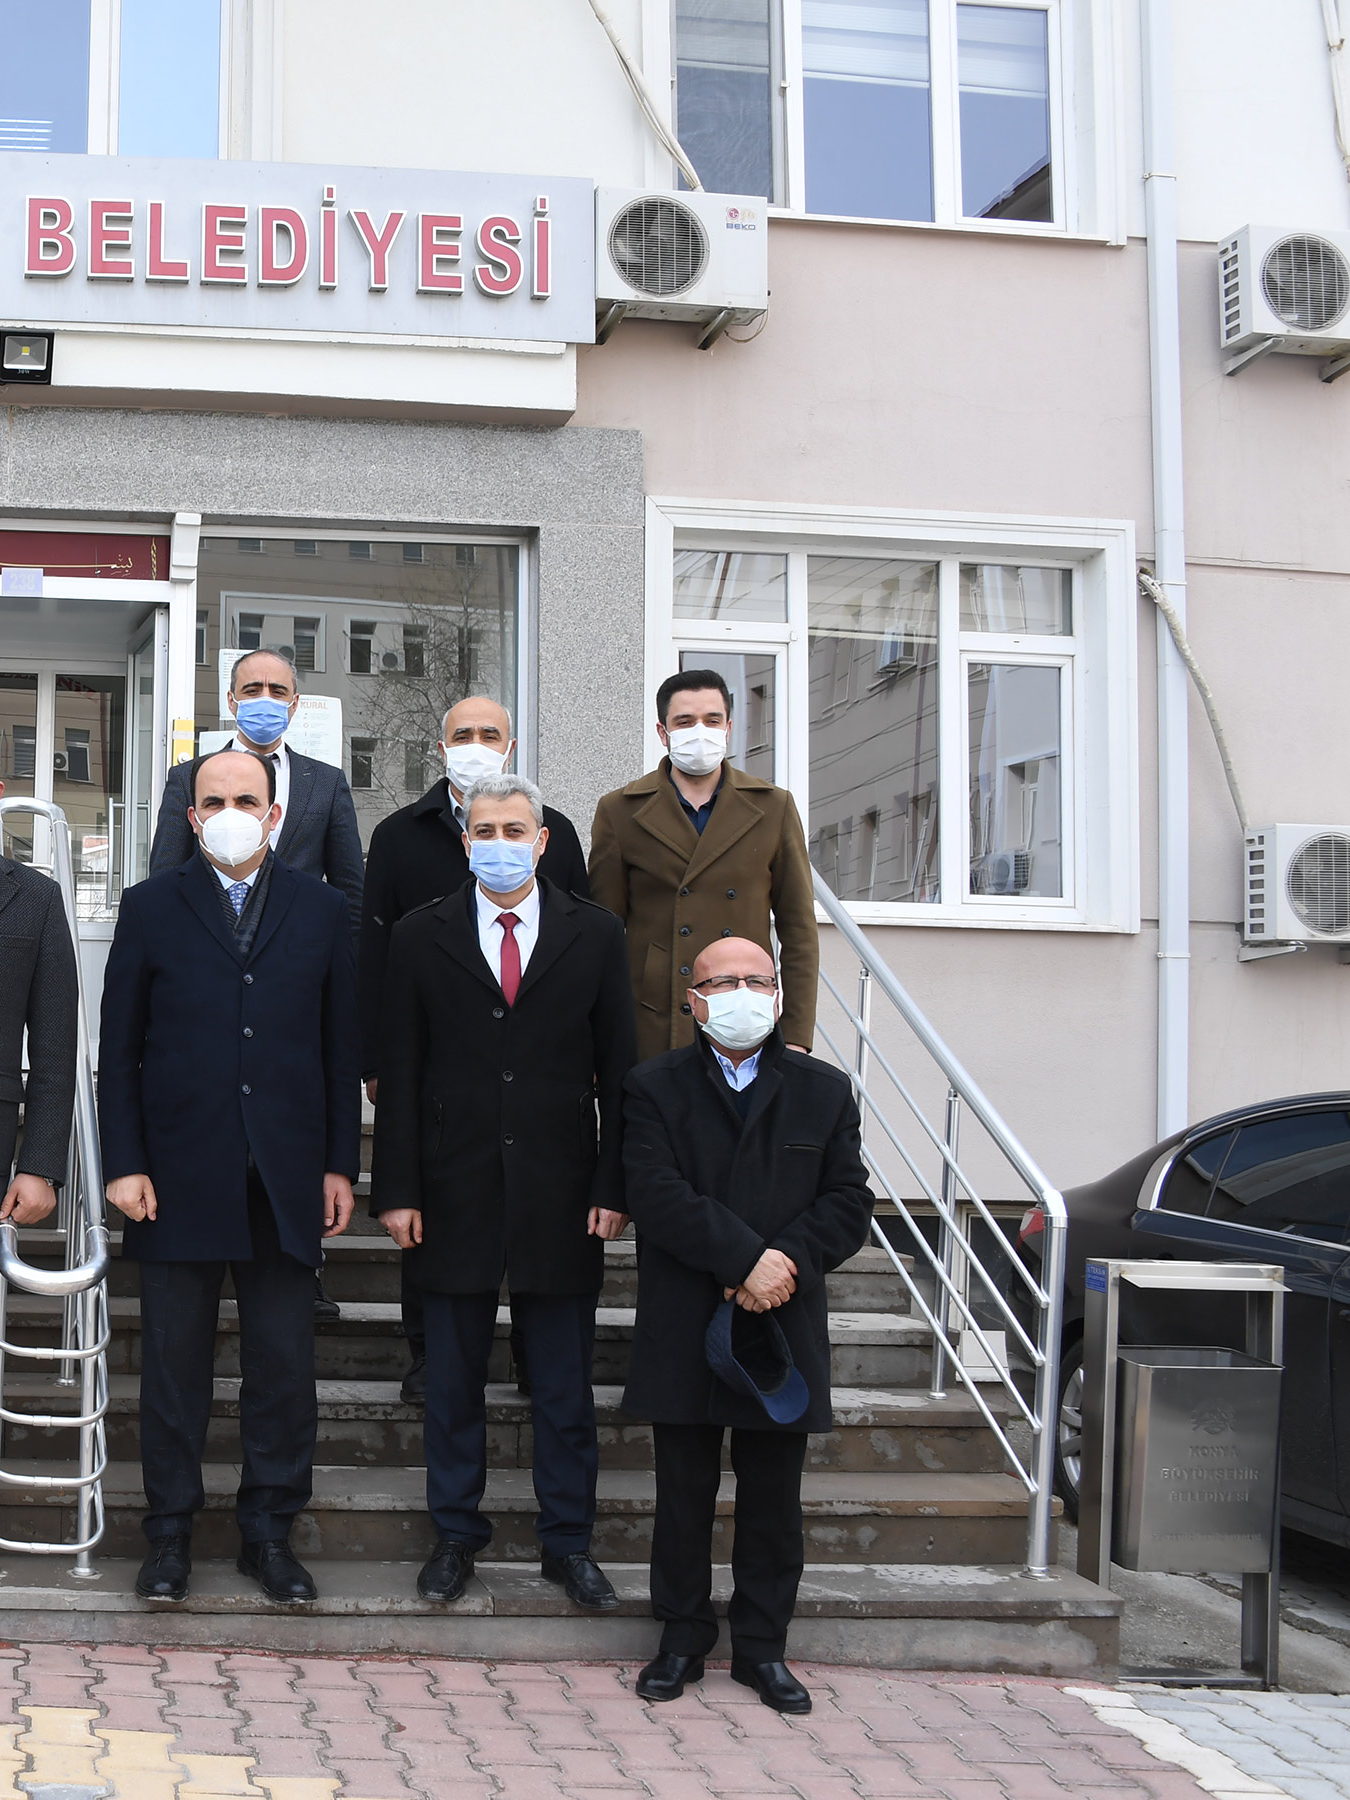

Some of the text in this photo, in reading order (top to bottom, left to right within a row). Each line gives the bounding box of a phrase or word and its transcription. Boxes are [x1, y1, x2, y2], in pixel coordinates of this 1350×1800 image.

[726, 222, 756, 231] BEKO
[24, 184, 551, 301] BELEDİYESİ
[9, 572, 36, 591] 238
